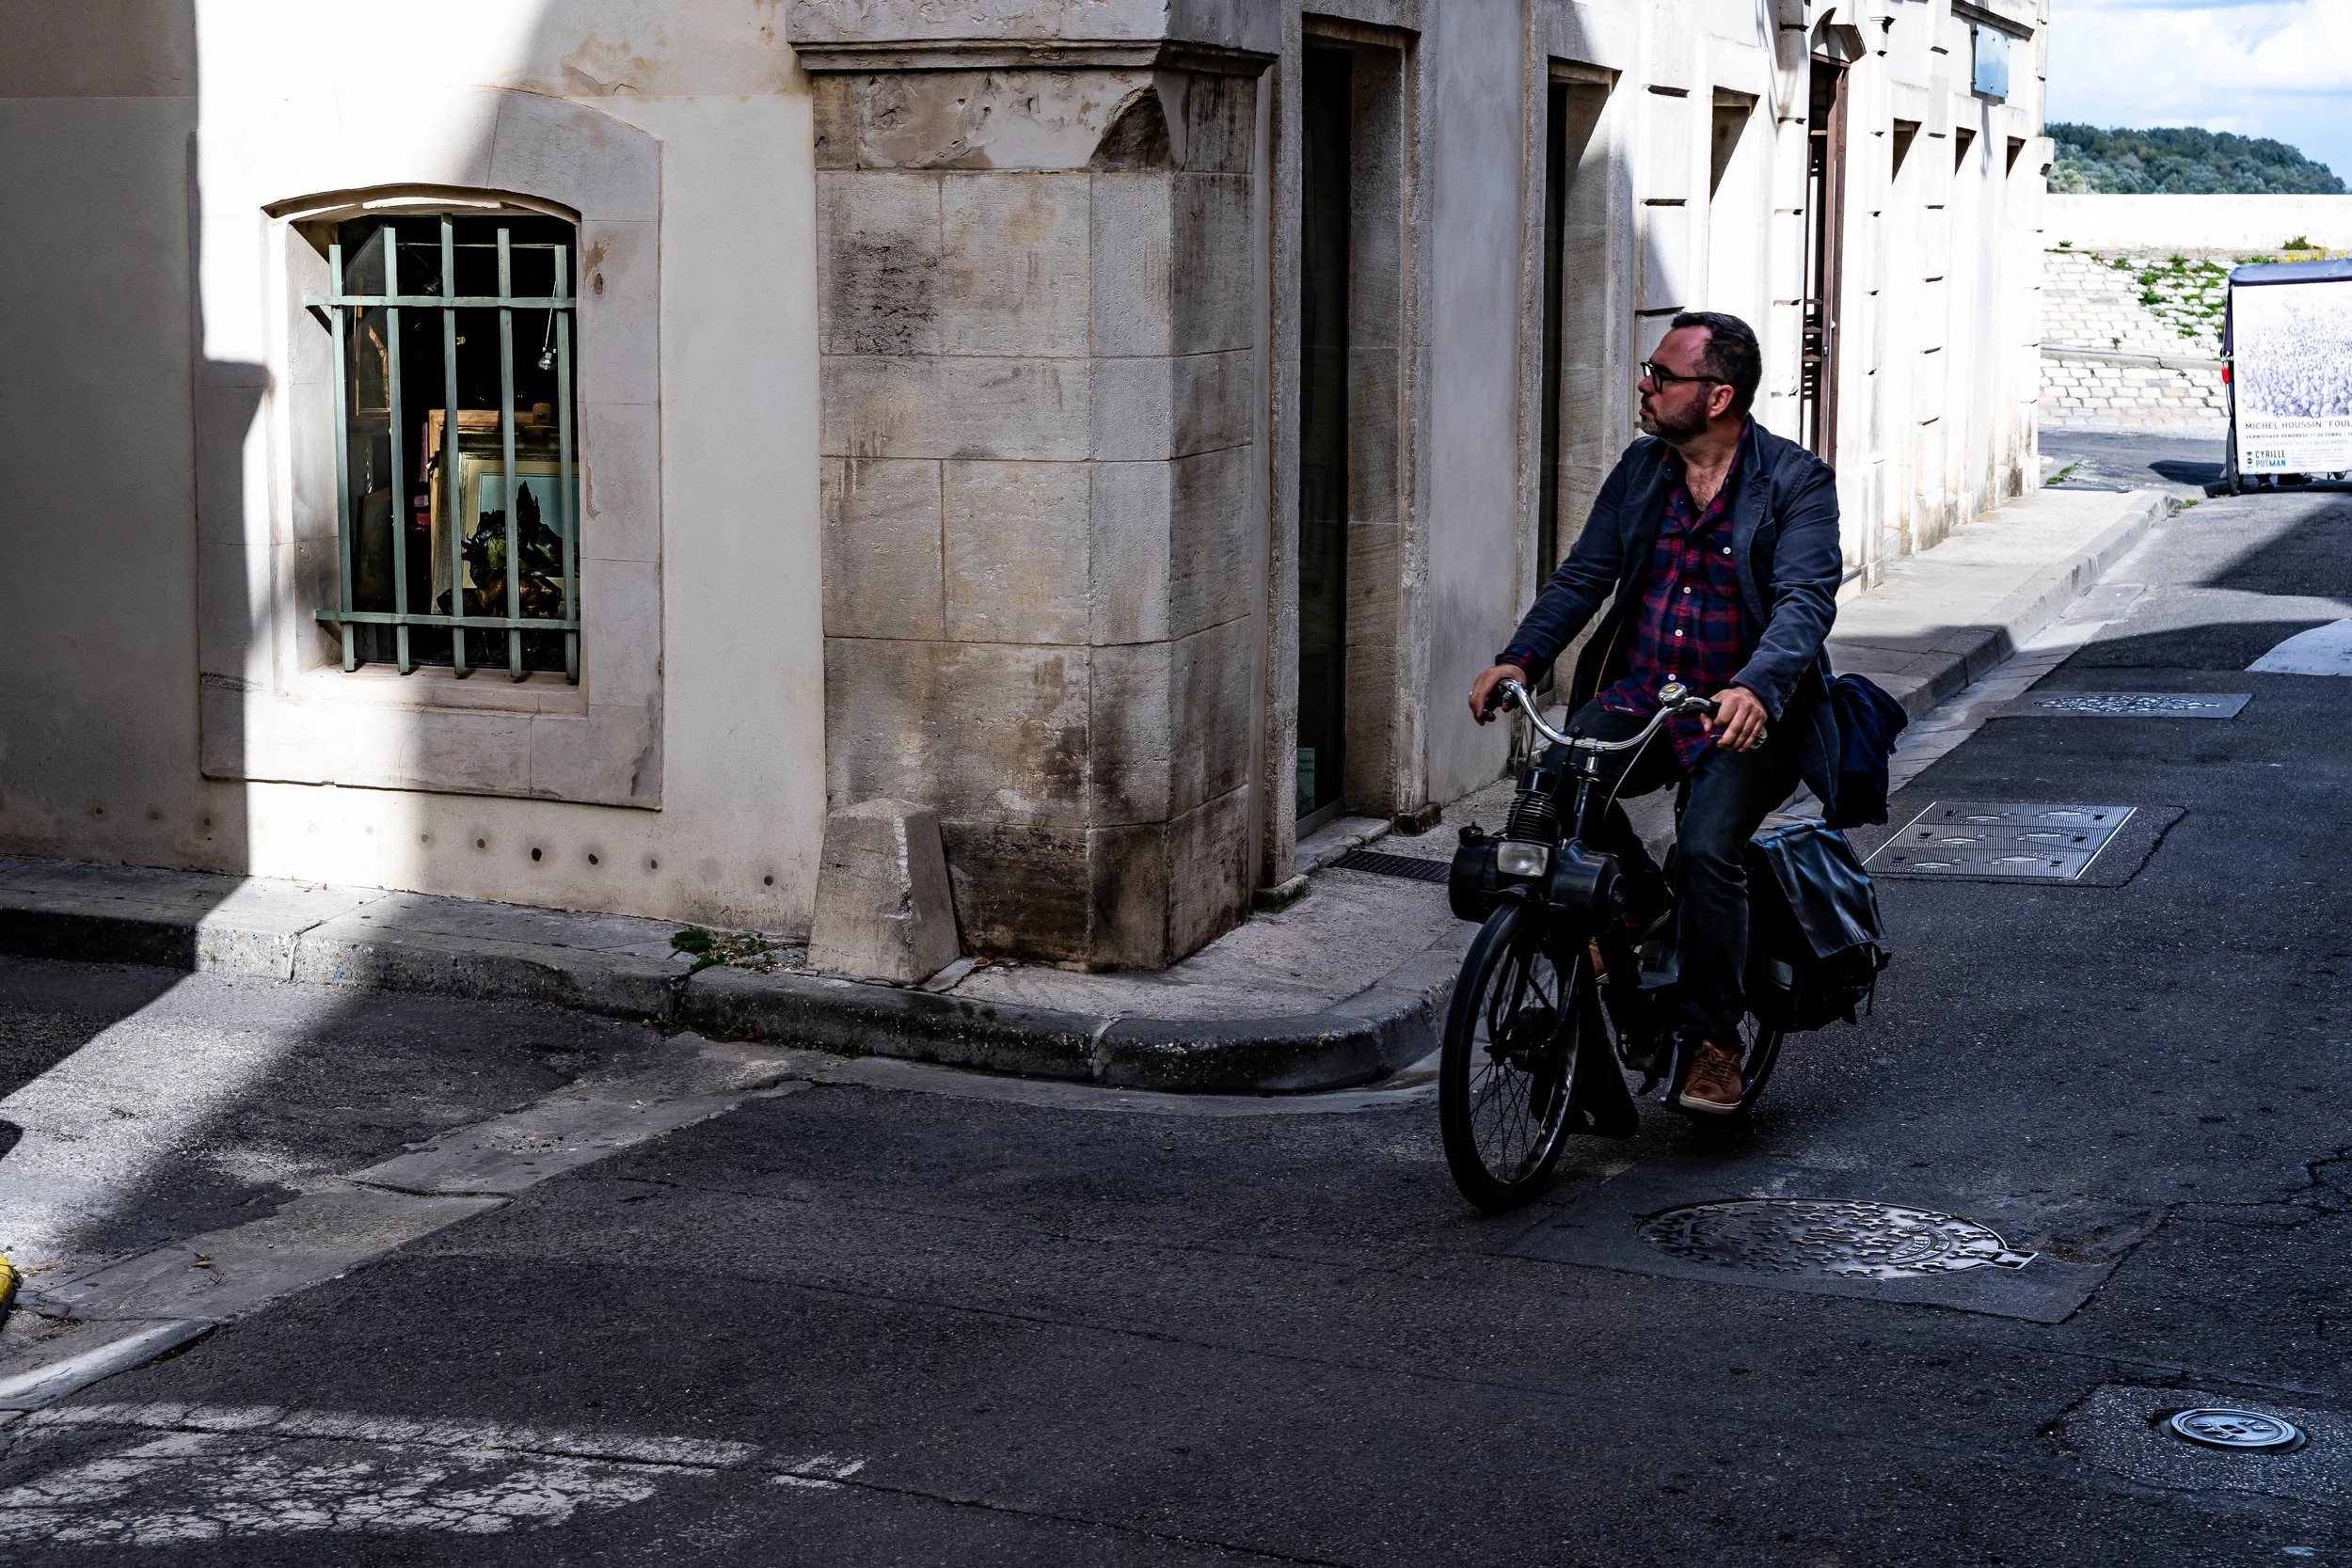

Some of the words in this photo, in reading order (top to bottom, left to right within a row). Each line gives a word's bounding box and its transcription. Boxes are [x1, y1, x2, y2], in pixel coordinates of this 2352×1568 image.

[2245, 421, 2279, 430] MICHEL
[2281, 420, 2322, 429] HOUSSIN
[2255, 450, 2285, 459] CYRILLE
[2255, 459, 2286, 467] PUTMAN
